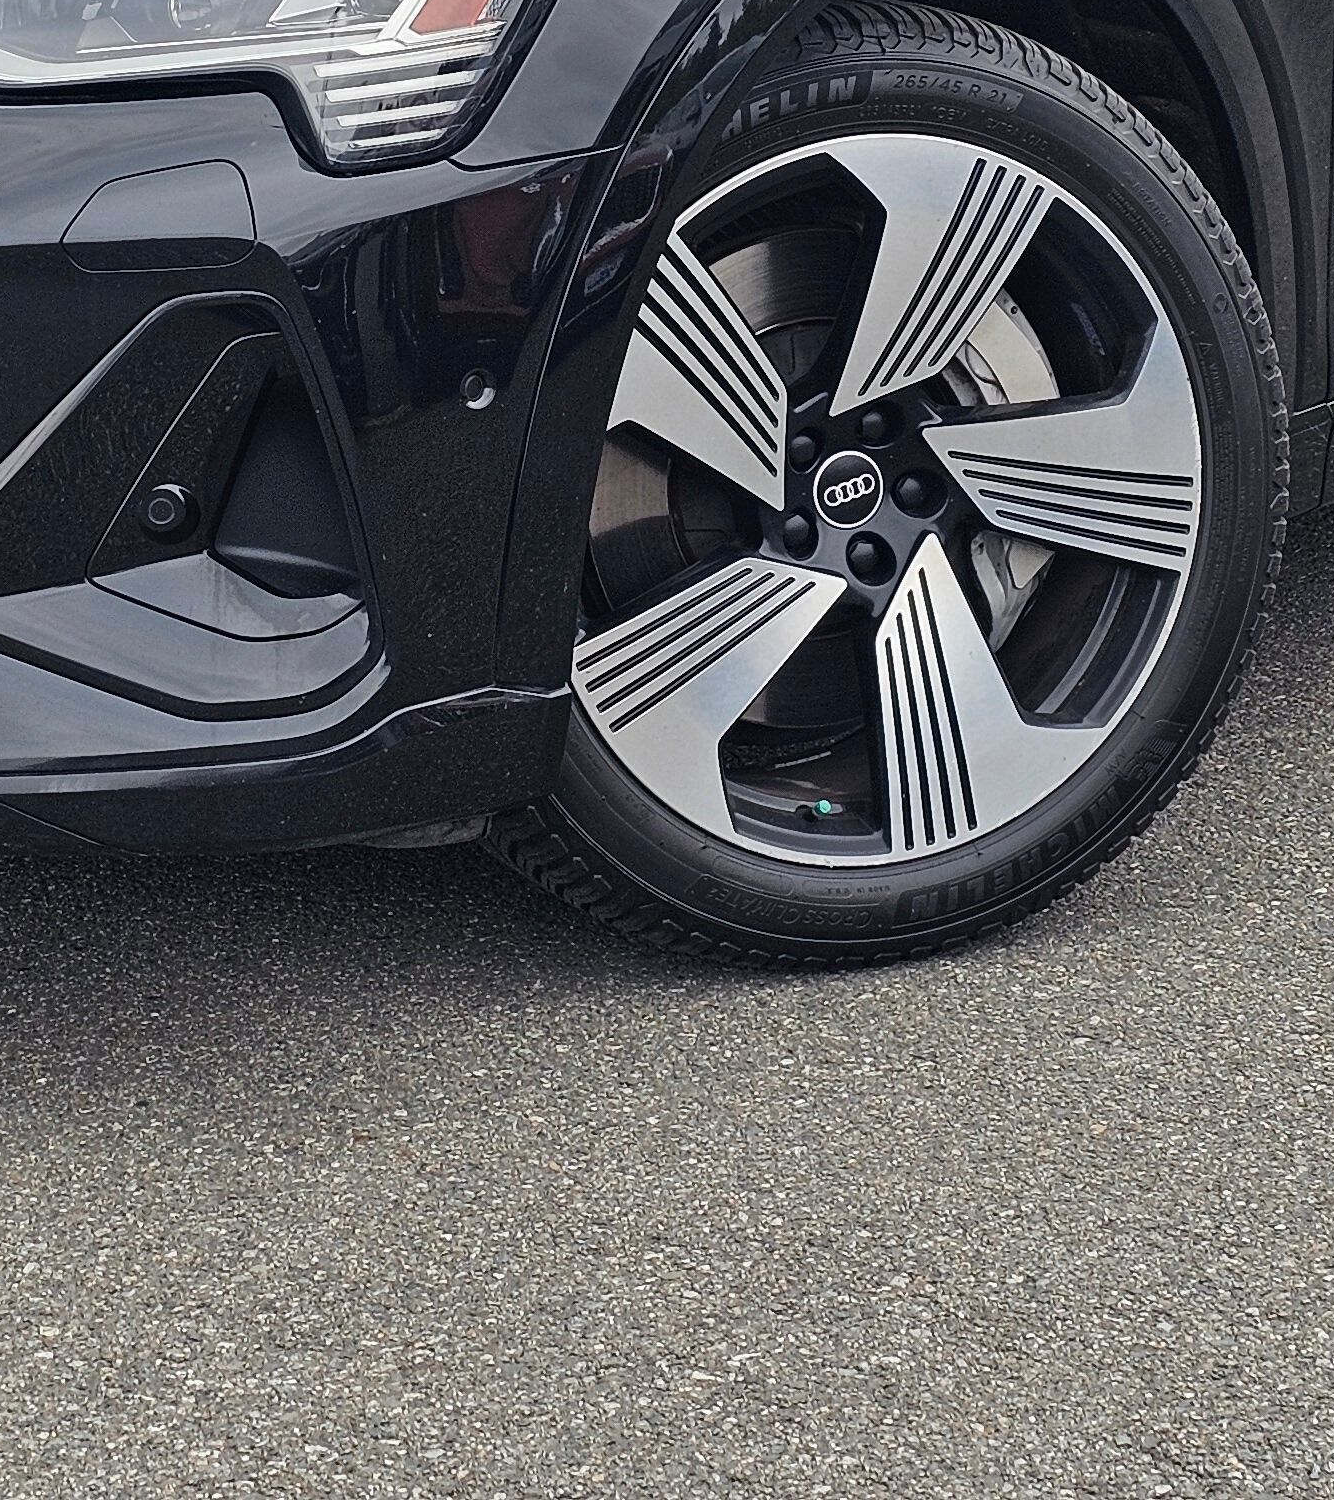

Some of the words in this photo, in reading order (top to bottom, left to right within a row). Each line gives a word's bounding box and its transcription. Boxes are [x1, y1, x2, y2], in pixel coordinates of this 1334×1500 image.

[722, 76, 856, 142] HELIN
[893, 73, 962, 95] 265/45
[969, 81, 980, 98] R
[990, 87, 1009, 106] 21
[908, 785, 1121, 921] MICHELIN
